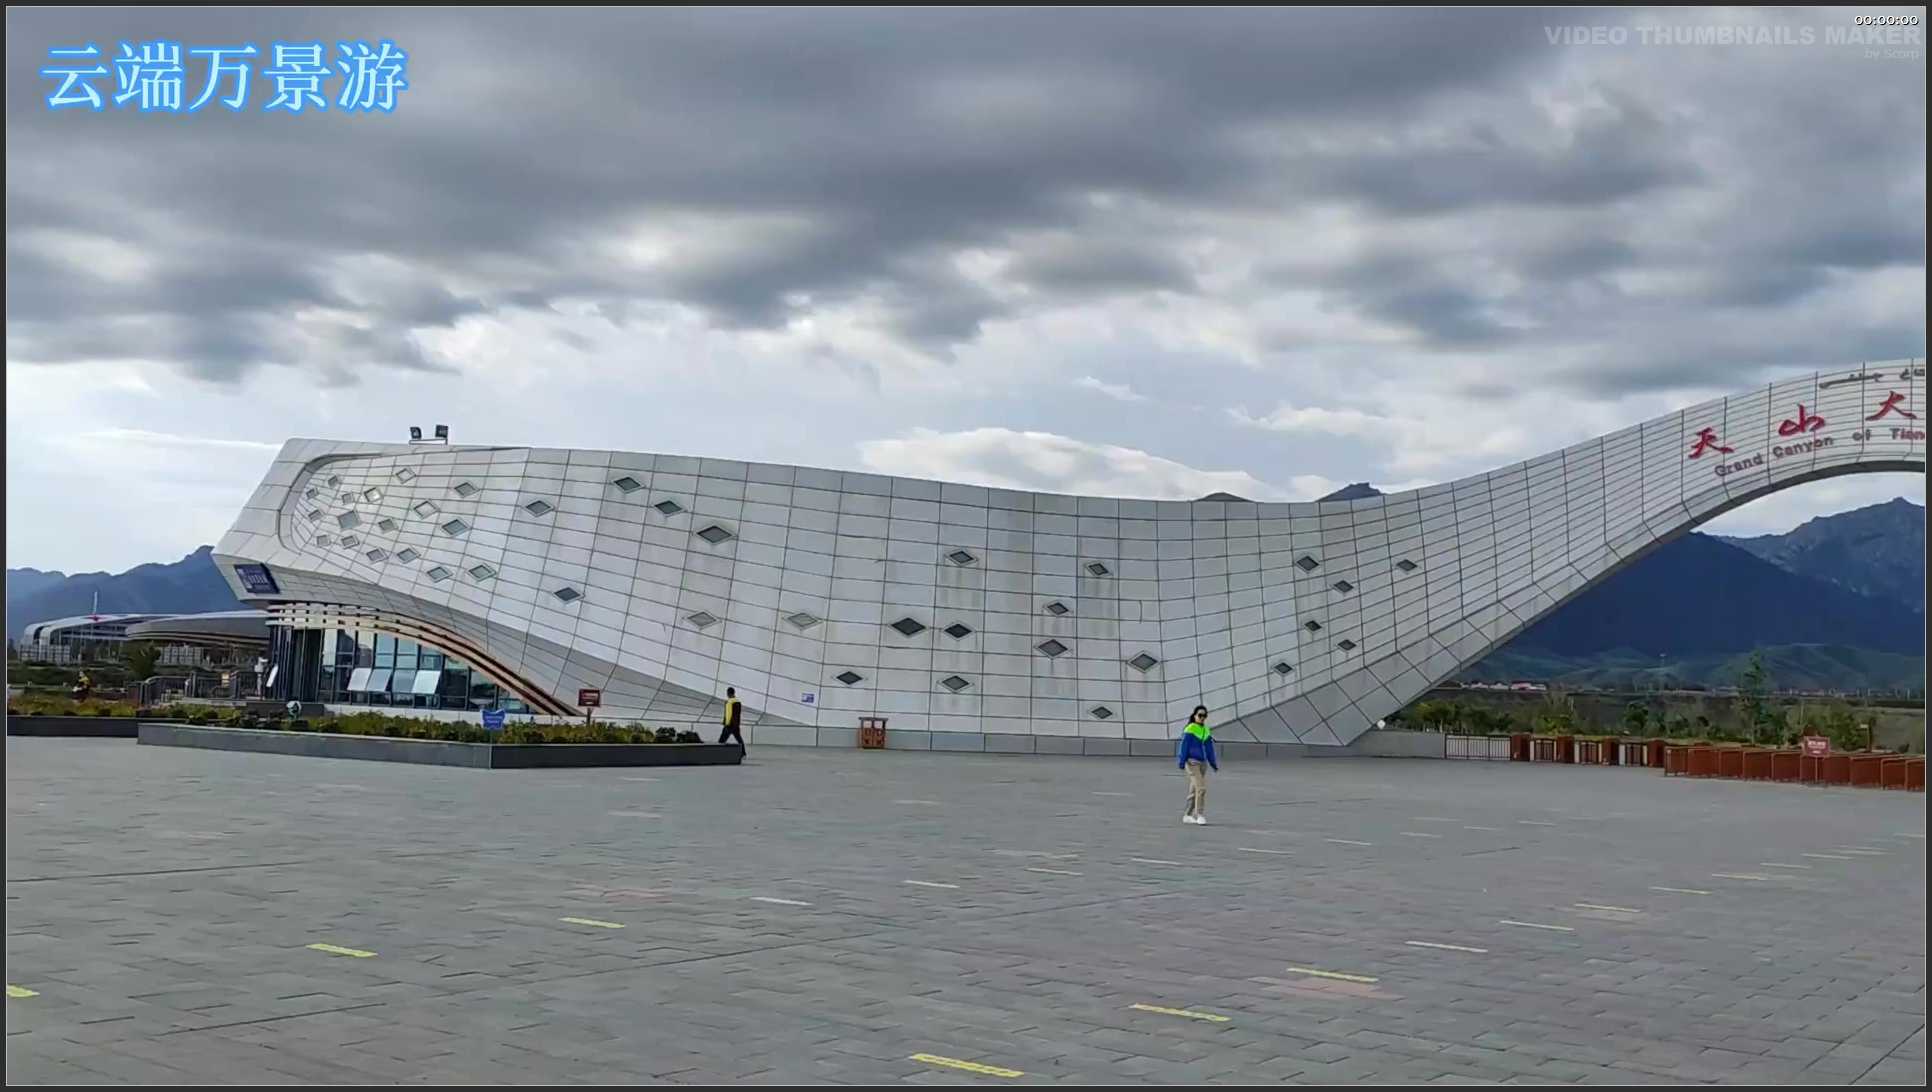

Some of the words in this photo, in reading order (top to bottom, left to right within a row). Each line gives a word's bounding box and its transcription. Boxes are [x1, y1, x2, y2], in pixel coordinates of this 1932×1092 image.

[1714, 454, 1764, 477] Grand
[1772, 437, 1834, 459] Canyon
[1852, 429, 1871, 441] of
[1889, 427, 1925, 440] Tian
